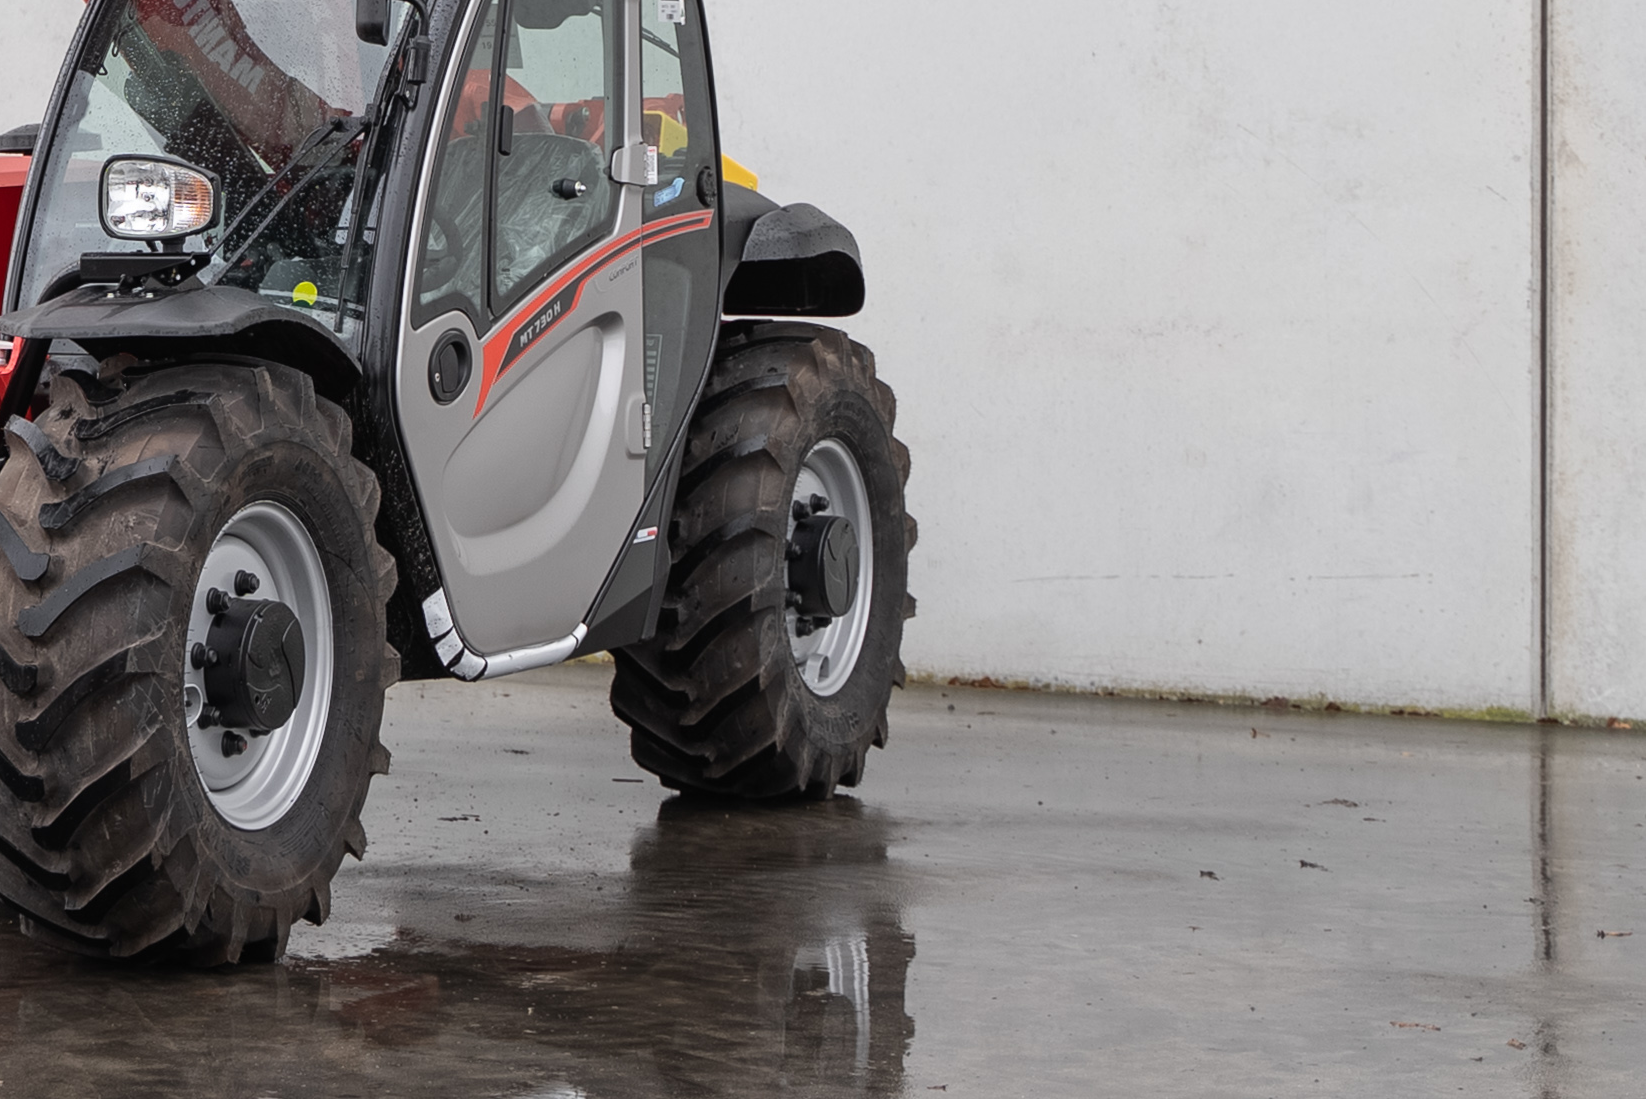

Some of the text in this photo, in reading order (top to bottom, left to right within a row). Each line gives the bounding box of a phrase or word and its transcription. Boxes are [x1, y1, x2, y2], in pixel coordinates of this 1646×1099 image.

[519, 300, 561, 348] MT 730 H
